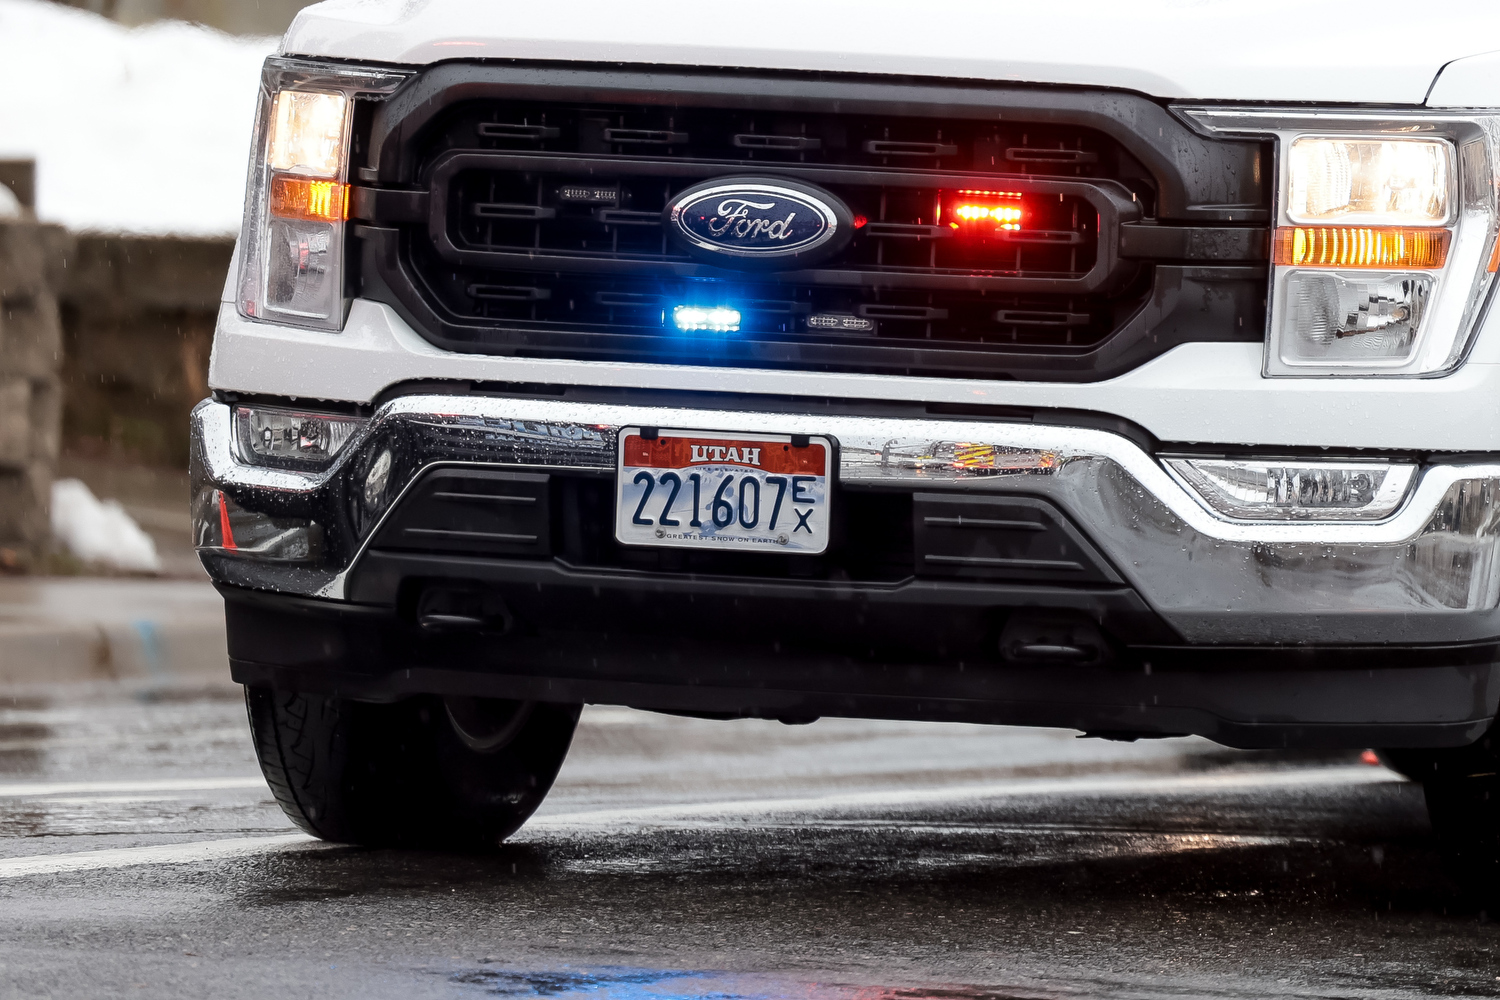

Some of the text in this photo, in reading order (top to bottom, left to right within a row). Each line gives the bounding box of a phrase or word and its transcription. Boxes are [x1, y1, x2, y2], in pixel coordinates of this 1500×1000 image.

[708, 198, 796, 240] Ford
[690, 444, 761, 466] UTAH
[632, 470, 787, 531] 221607
[666, 532, 709, 541] GREATEST
